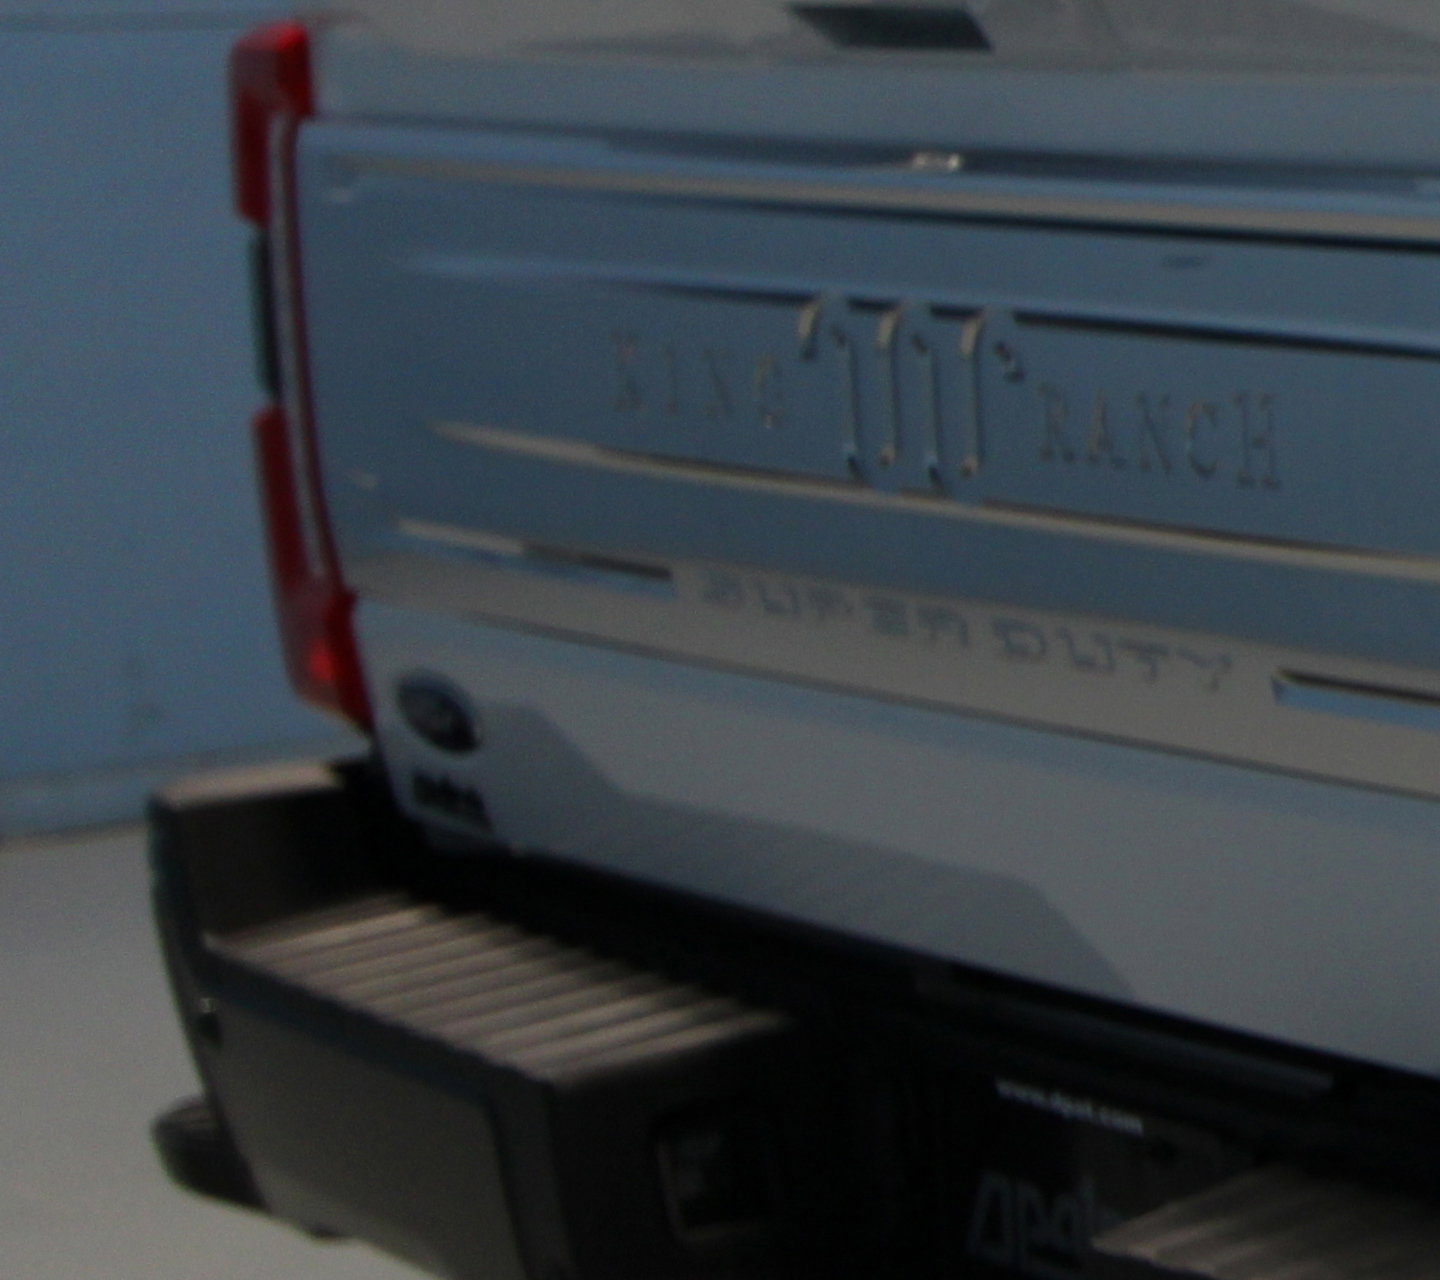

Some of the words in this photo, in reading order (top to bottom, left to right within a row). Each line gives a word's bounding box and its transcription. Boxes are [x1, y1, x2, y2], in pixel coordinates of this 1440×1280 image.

[1037, 381, 1281, 490] RANCH
[701, 568, 970, 649] SUPER
[993, 616, 1233, 691] DUTY
